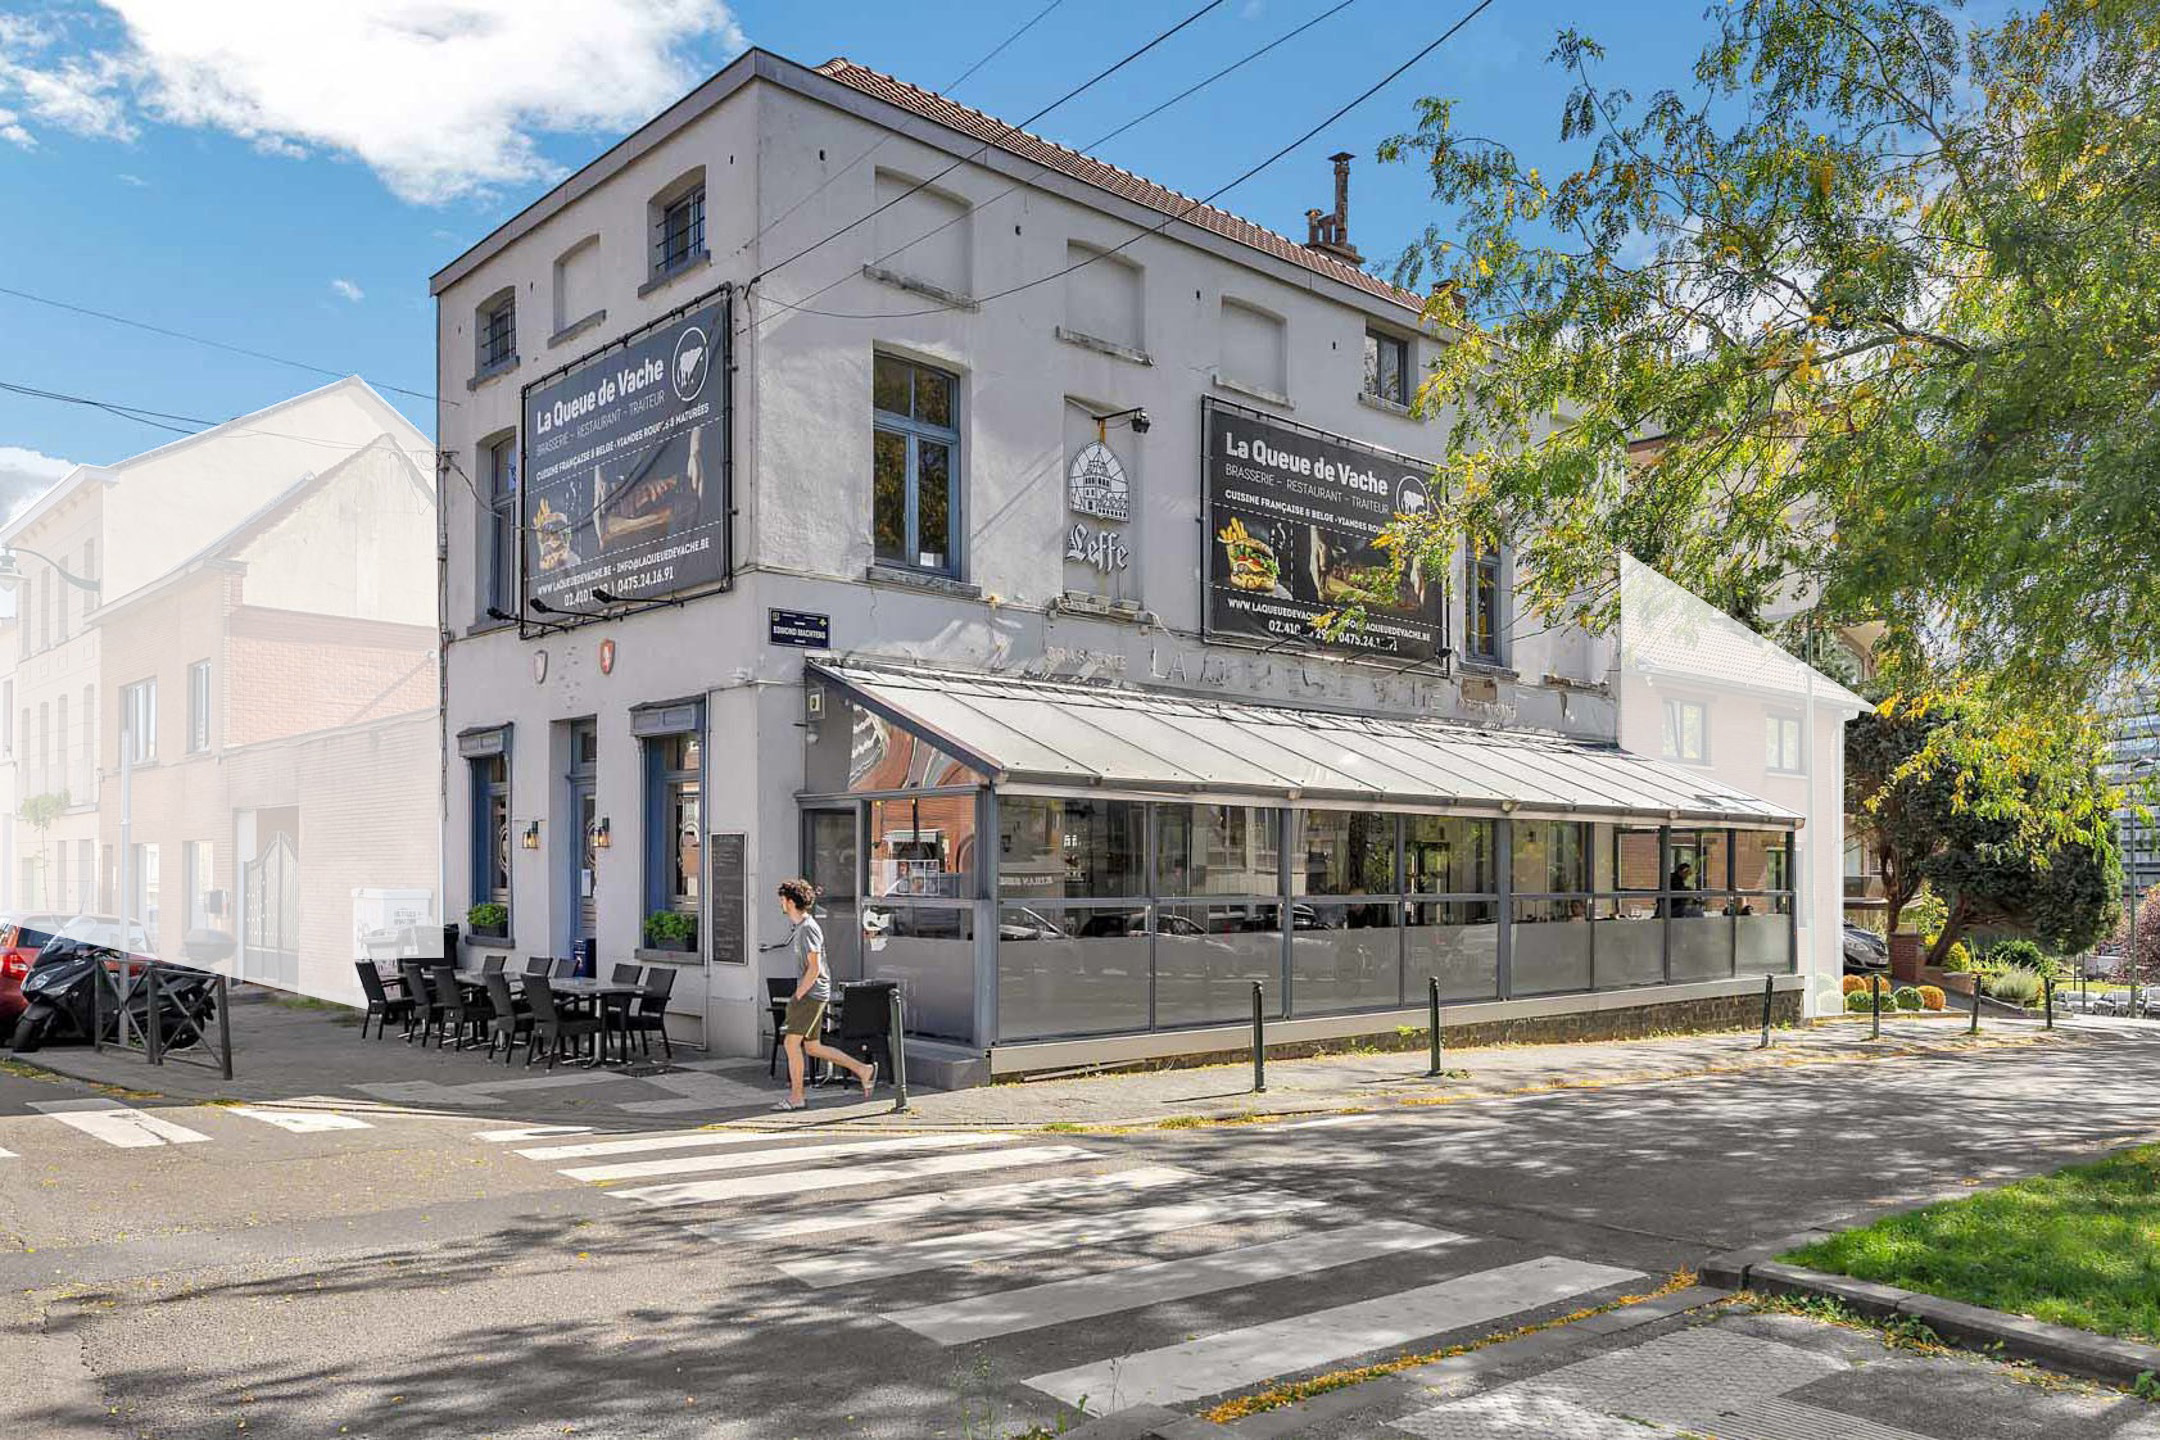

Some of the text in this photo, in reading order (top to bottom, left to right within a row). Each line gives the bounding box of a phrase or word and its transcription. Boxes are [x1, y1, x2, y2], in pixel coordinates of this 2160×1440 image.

[537, 358, 664, 434] La Queue de Vache
[577, 408, 622, 438] RESTAURANT
[629, 390, 665, 416] TRAITEUR
[536, 462, 559, 482] CUISINE
[596, 441, 614, 457] BELGE
[617, 431, 644, 449] VIANDES
[675, 402, 710, 426] MATURÉES
[1226, 432, 1389, 496] La Queue de Vache
[1225, 463, 1275, 486] BRASSERIE
[1286, 479, 1342, 503] RESTAURANT
[1351, 495, 1389, 515] TRAITEUR
[1225, 489, 1260, 506] CUISINE
[1260, 497, 1305, 516] FRANÇAISE
[1311, 510, 1334, 524] BELGE
[1337, 516, 1367, 531] VIANDES
[1066, 523, 1129, 571] Leffe
[617, 566, 675, 593] 0475.24.16.91
